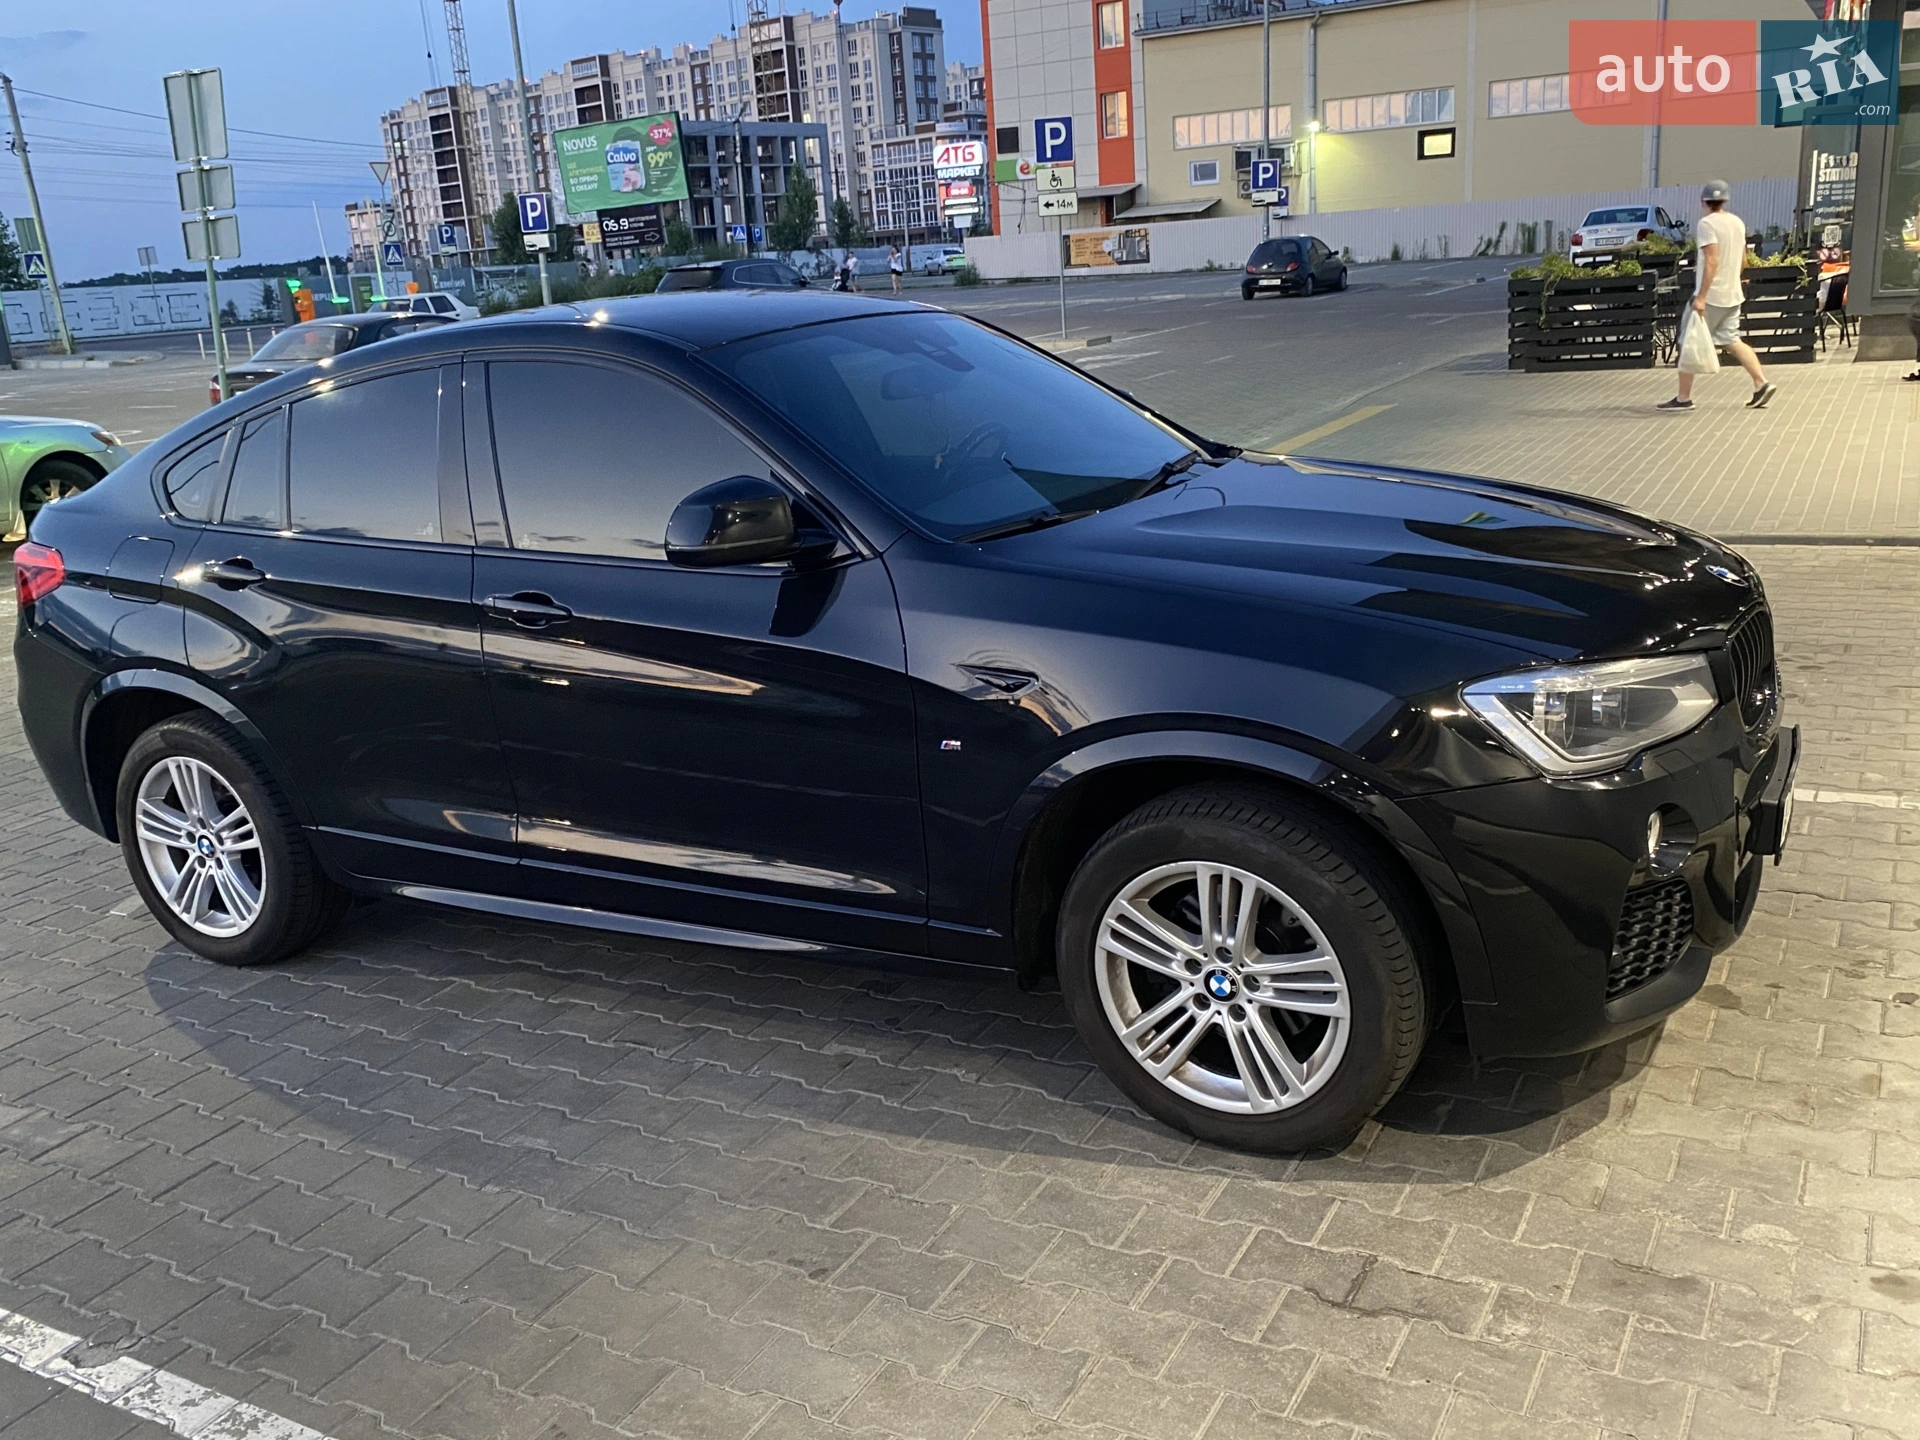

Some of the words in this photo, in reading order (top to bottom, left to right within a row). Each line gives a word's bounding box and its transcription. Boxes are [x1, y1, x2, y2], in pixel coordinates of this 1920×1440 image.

[562, 135, 598, 152] NOVUS
[1044, 121, 1067, 159] P
[607, 151, 637, 163] Calvo
[937, 166, 982, 179] МАРКЕТ
[1258, 162, 1274, 187] P
[1818, 167, 1857, 182] STATION
[525, 197, 542, 228] P
[441, 226, 451, 243] P
[754, 228, 761, 242] P
[1215, 969, 1238, 993] BMW
